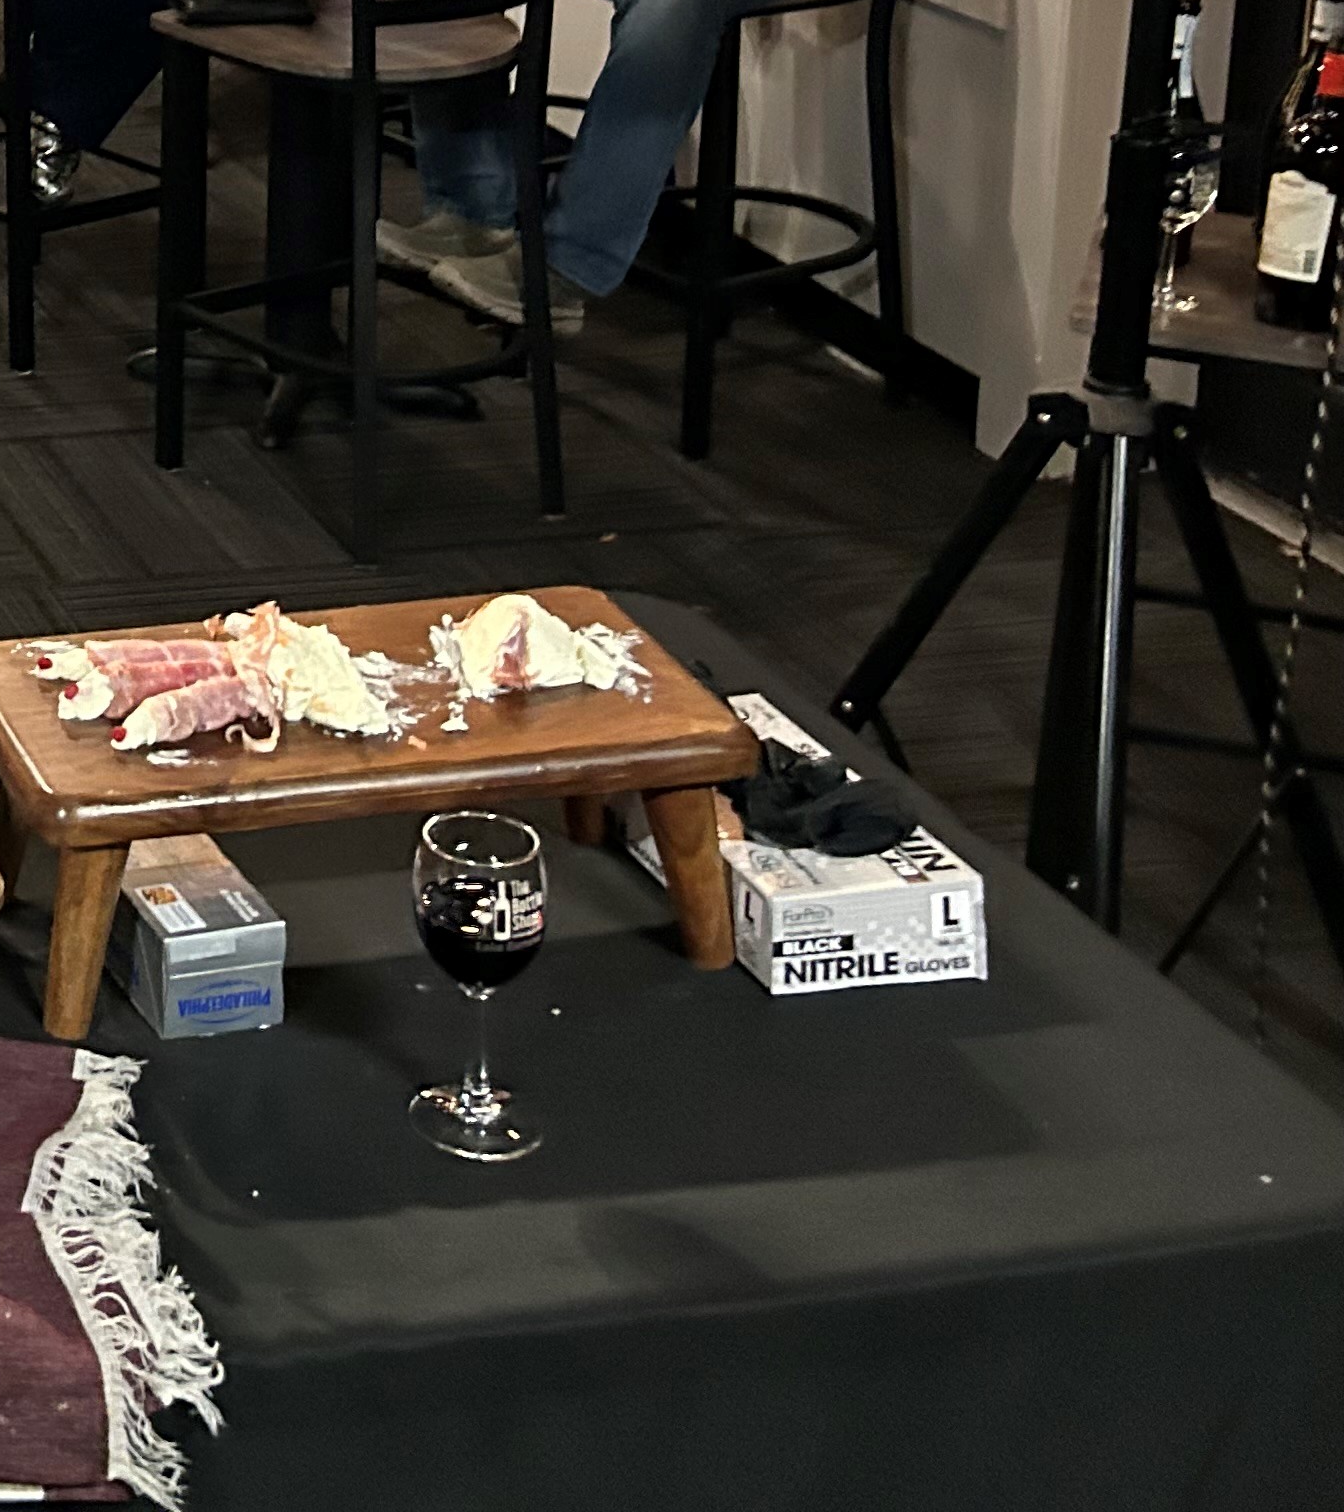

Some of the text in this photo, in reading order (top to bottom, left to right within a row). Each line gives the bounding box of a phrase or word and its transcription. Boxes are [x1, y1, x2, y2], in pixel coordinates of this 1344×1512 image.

[942, 895, 959, 927] L
[782, 937, 843, 955] BLACK
[784, 951, 971, 985] NITRILE GLOVES
[178, 986, 271, 1017] PHILADELPHIA
